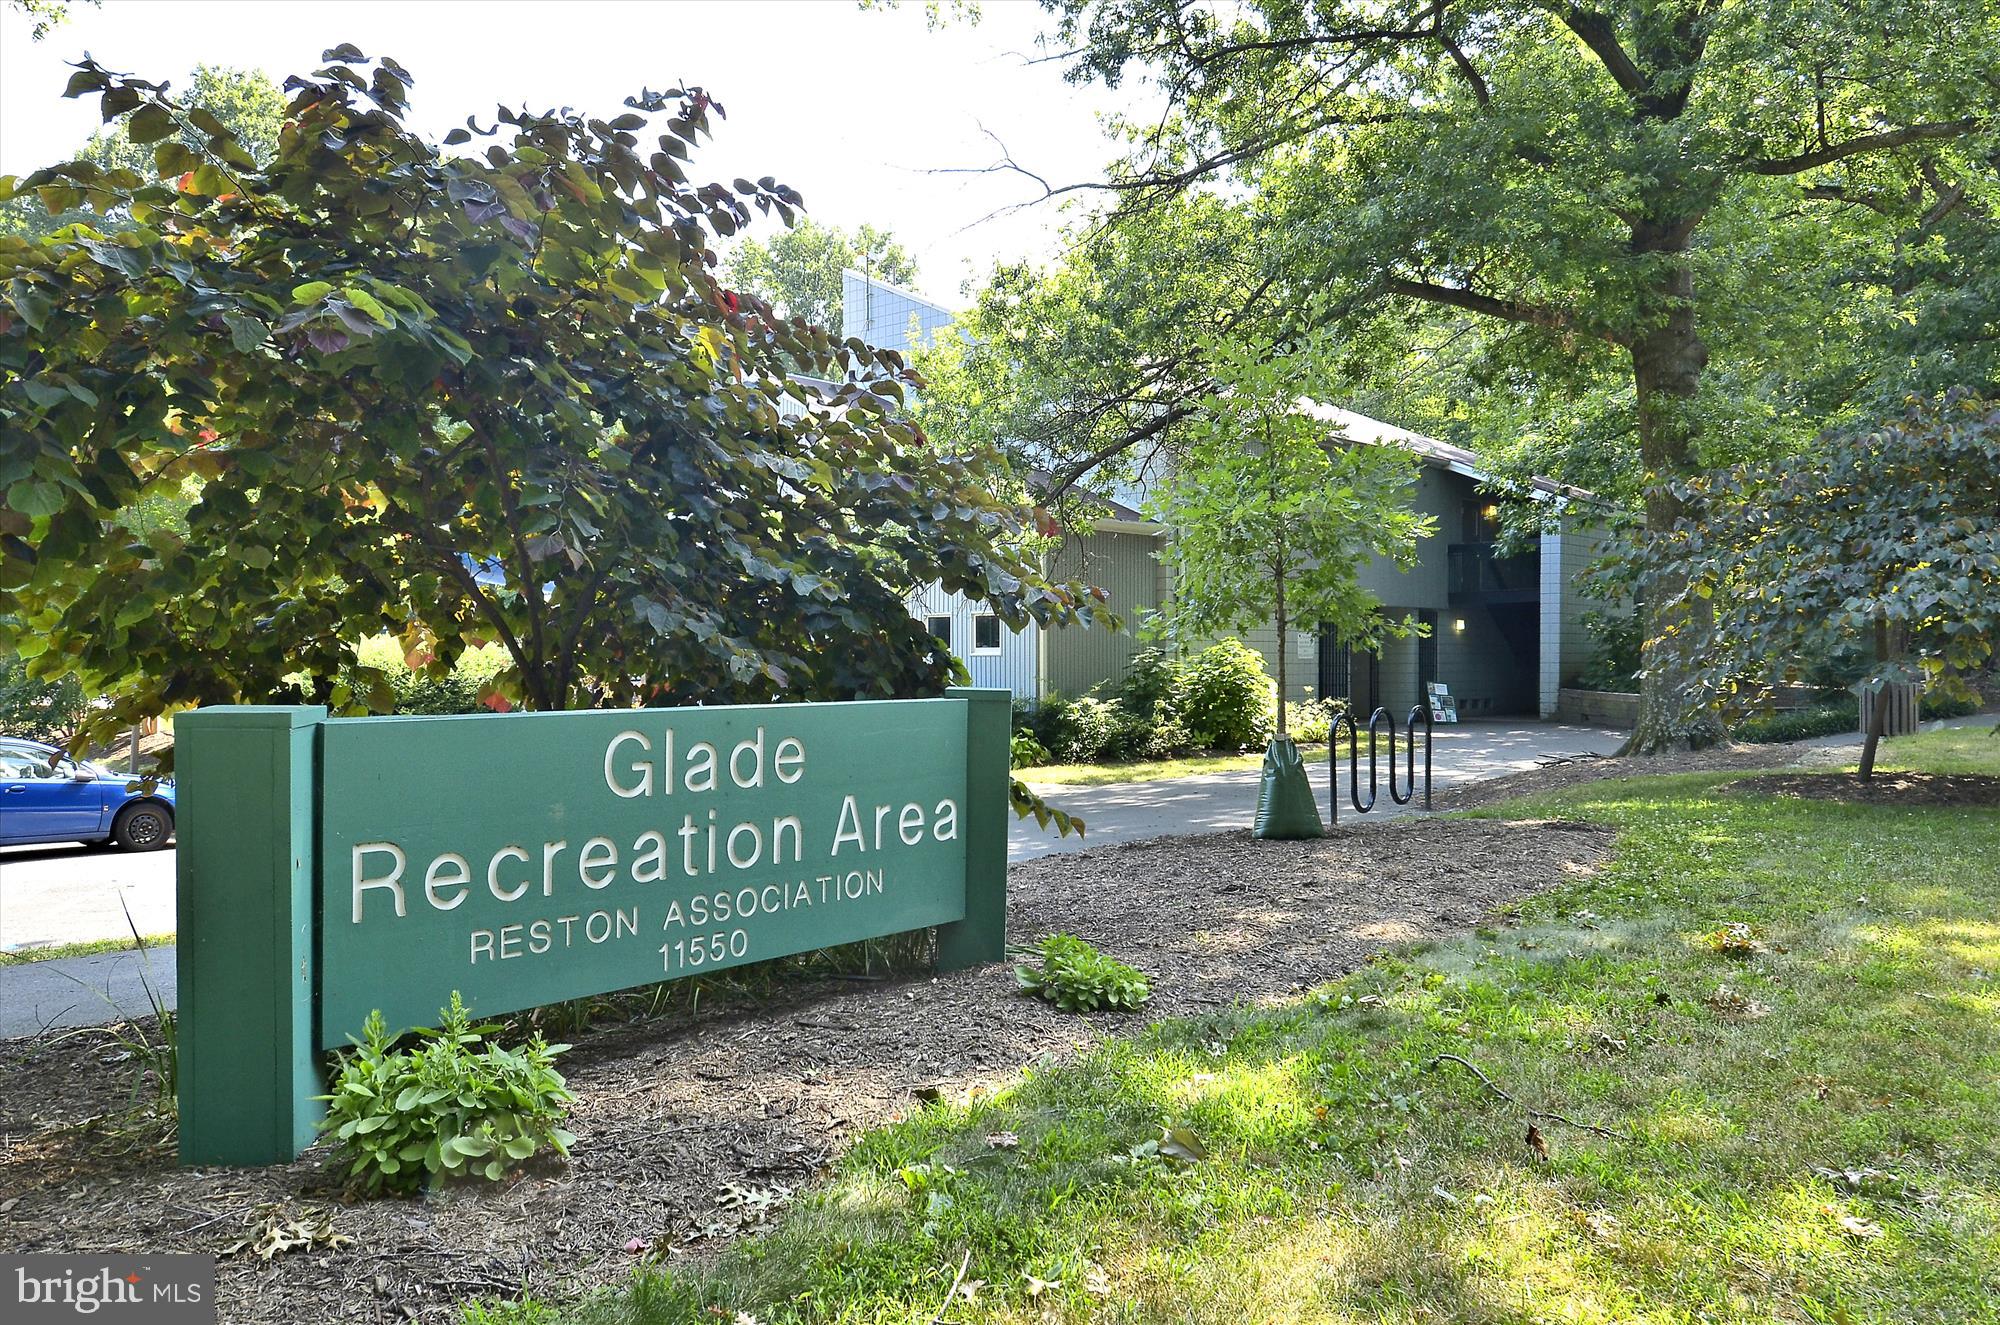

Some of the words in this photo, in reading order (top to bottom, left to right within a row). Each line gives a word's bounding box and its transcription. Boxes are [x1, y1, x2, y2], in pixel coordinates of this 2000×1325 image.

[603, 726, 806, 799] Glade
[351, 809, 802, 924] Recreation
[831, 794, 959, 857] Area
[470, 907, 639, 965] RESTON
[664, 868, 885, 931] ASSOCIATION
[658, 928, 750, 972] 11550
